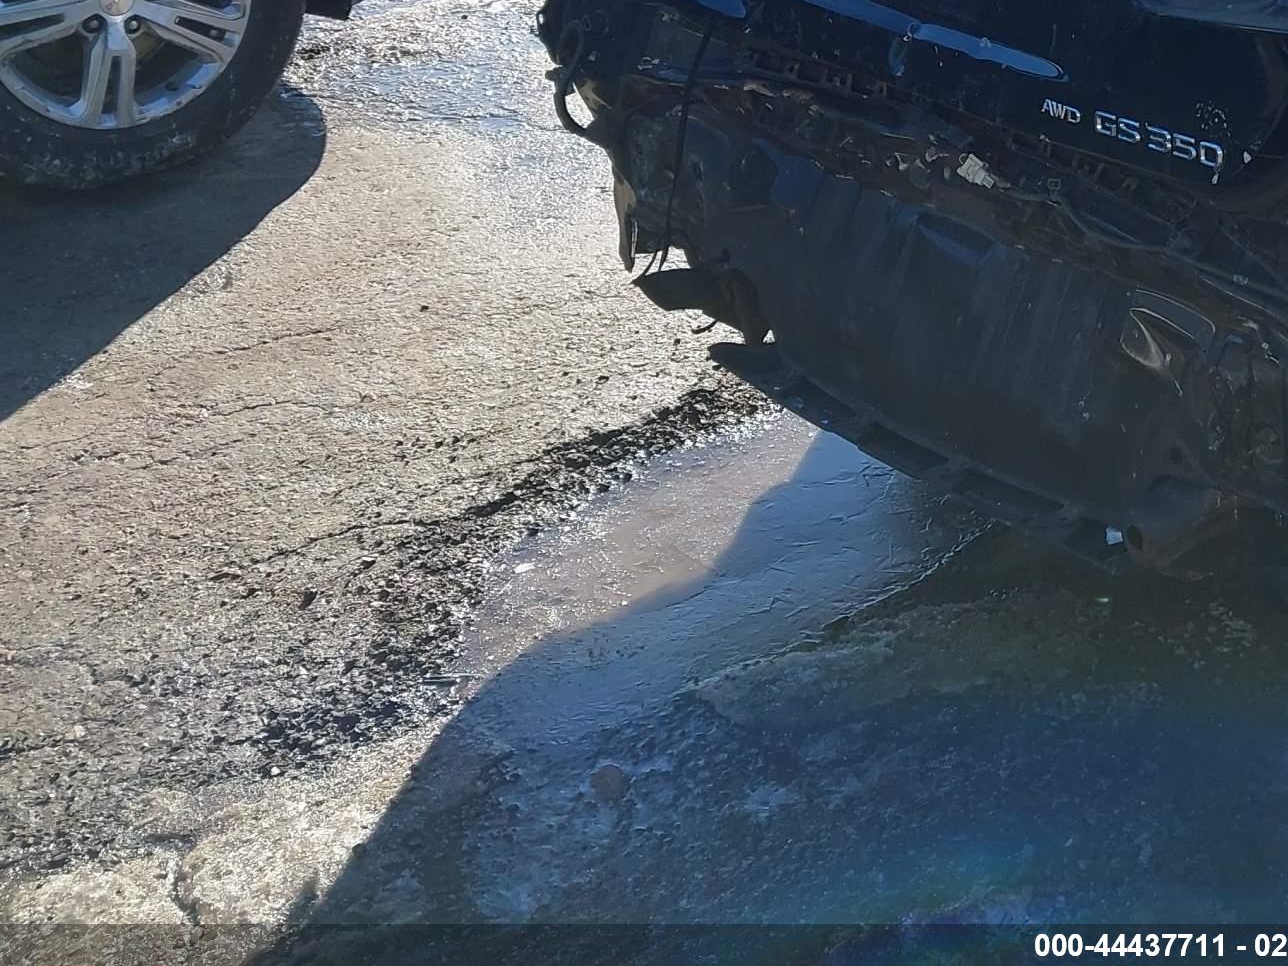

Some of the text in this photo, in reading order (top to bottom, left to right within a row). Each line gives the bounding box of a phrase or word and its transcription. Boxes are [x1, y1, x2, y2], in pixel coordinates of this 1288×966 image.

[1041, 98, 1224, 170] AWD GS 350
